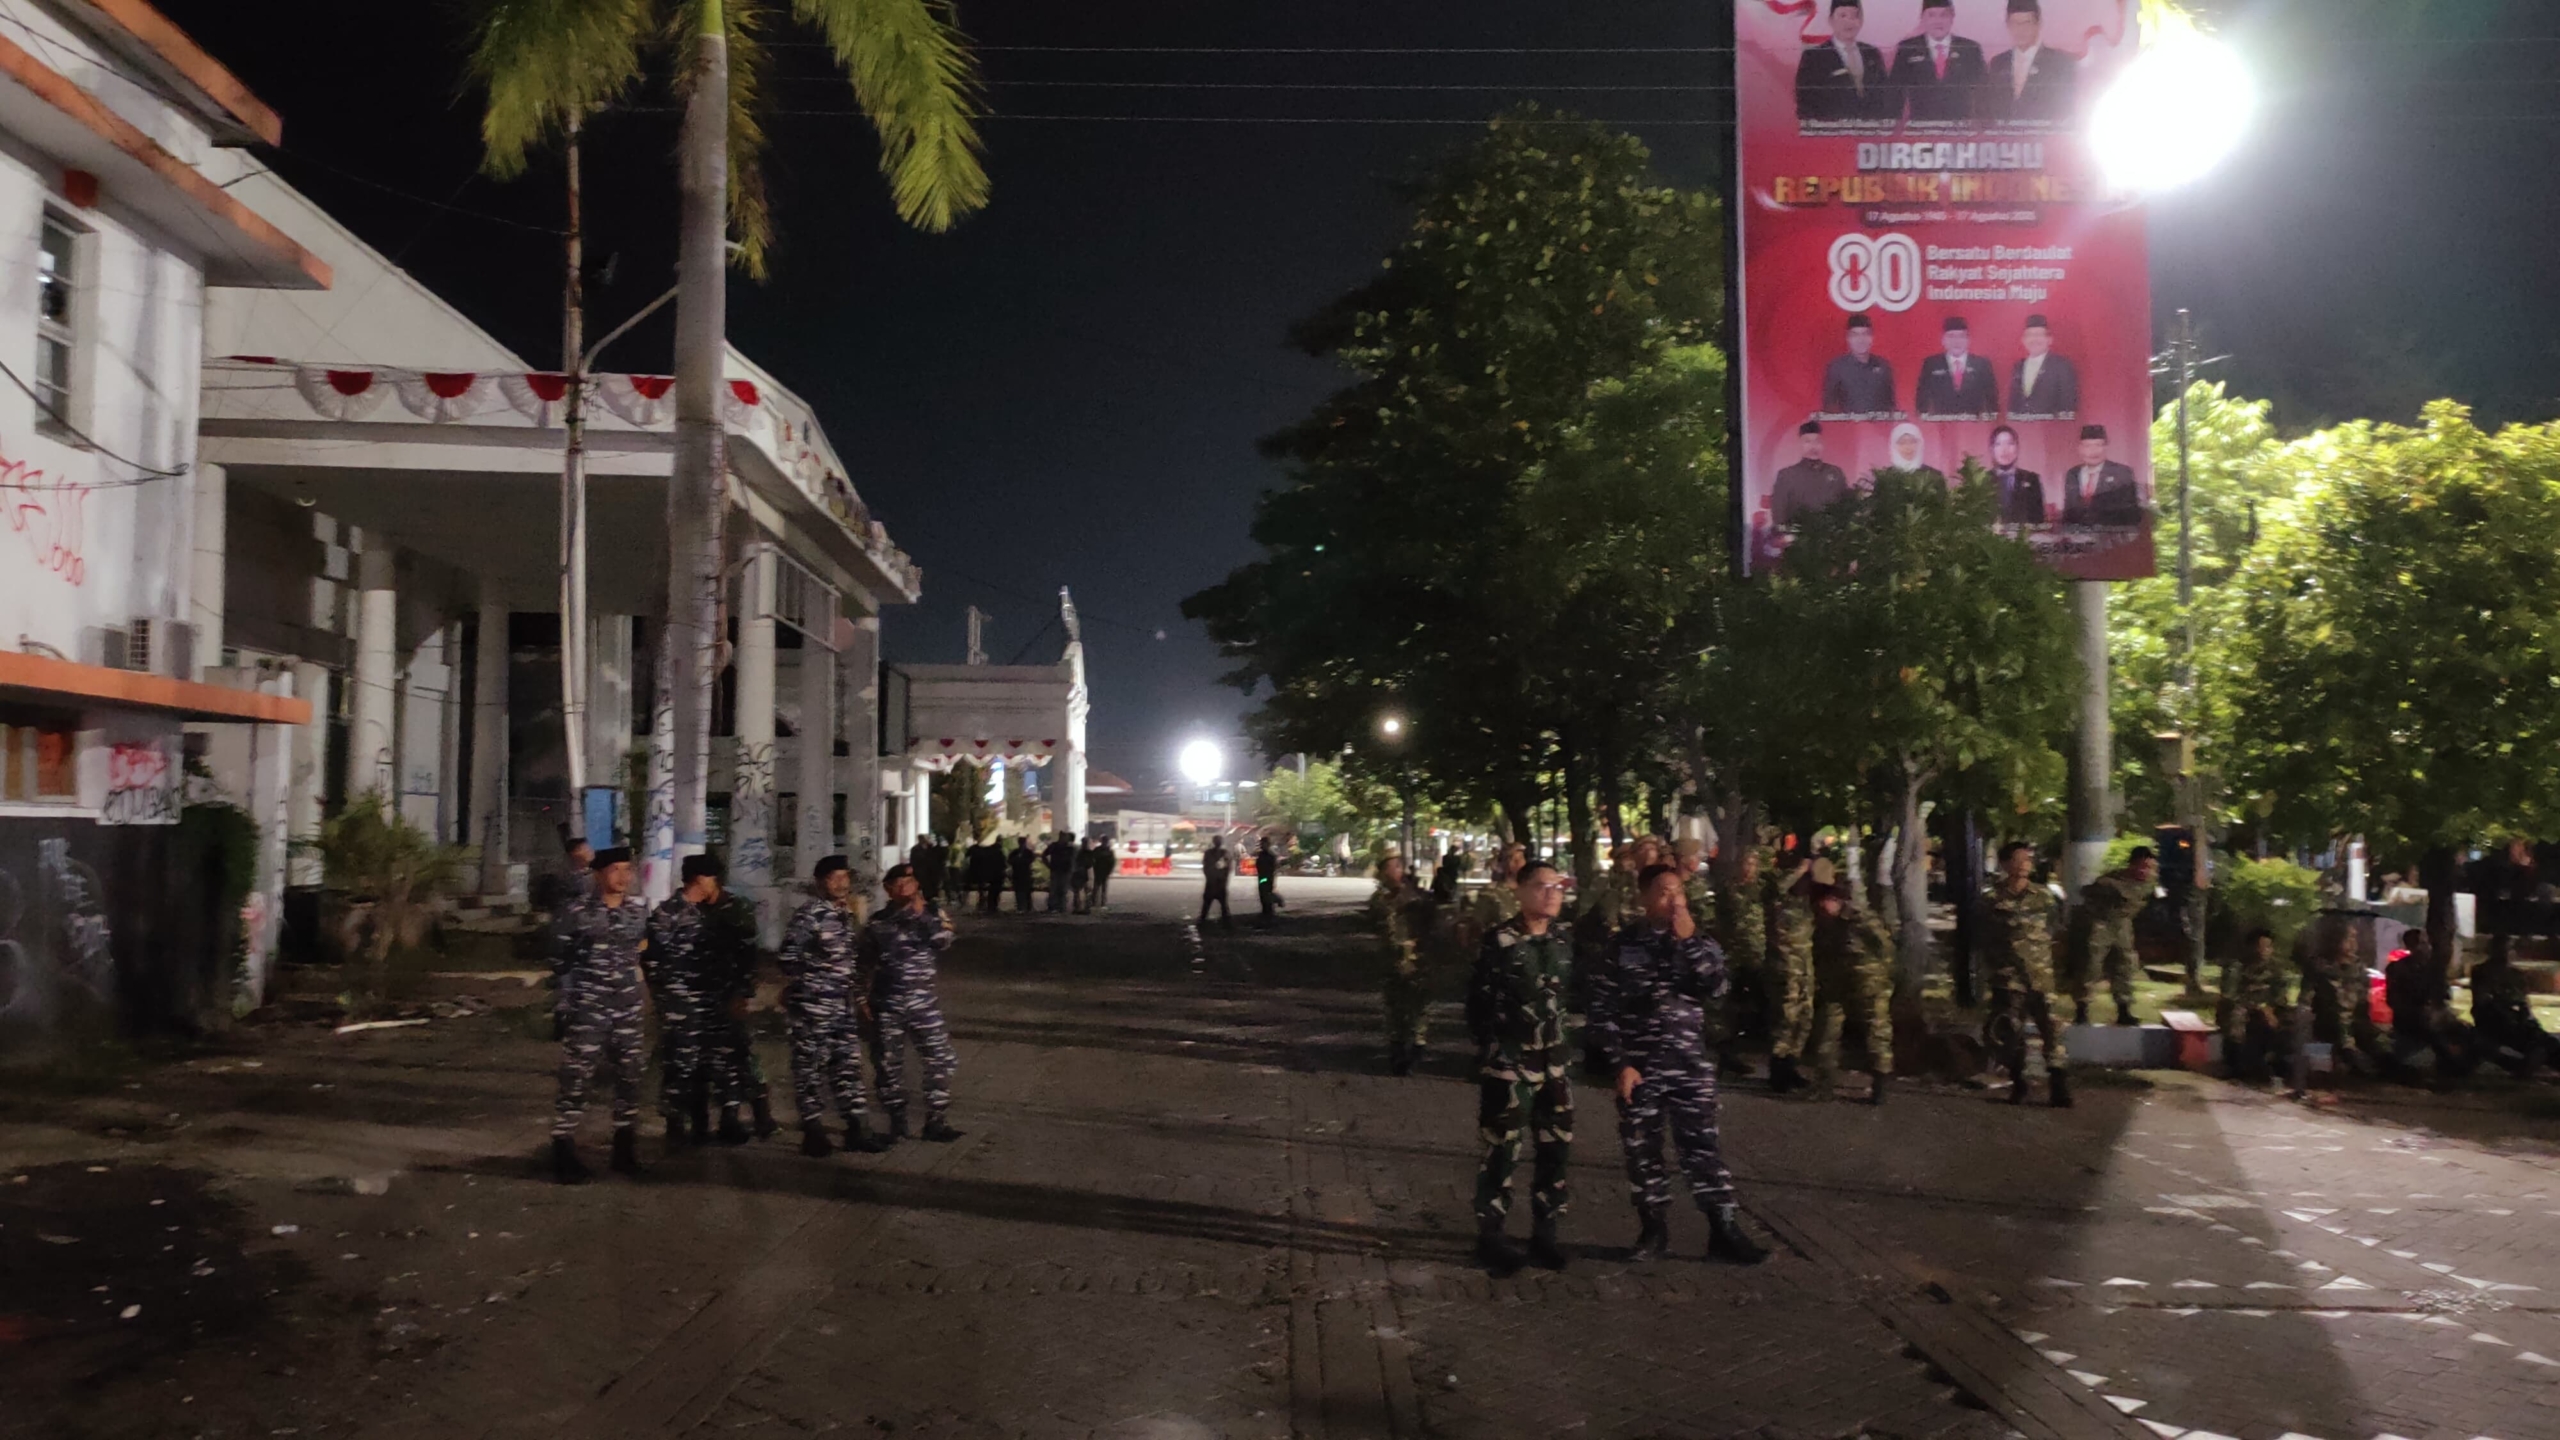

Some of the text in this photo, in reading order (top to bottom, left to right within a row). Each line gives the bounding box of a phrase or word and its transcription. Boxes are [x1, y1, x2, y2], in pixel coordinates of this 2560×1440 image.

[1858, 142, 2044, 170] DIRGAHAYU
[1774, 176, 1940, 203] REPUBIK
[1926, 245, 2073, 260] Bersatu Berdaulat
[1828, 233, 1922, 312] 80
[1926, 264, 2066, 284] Rakyat Sejahtera
[1926, 285, 2048, 303] Indonesia Maju
